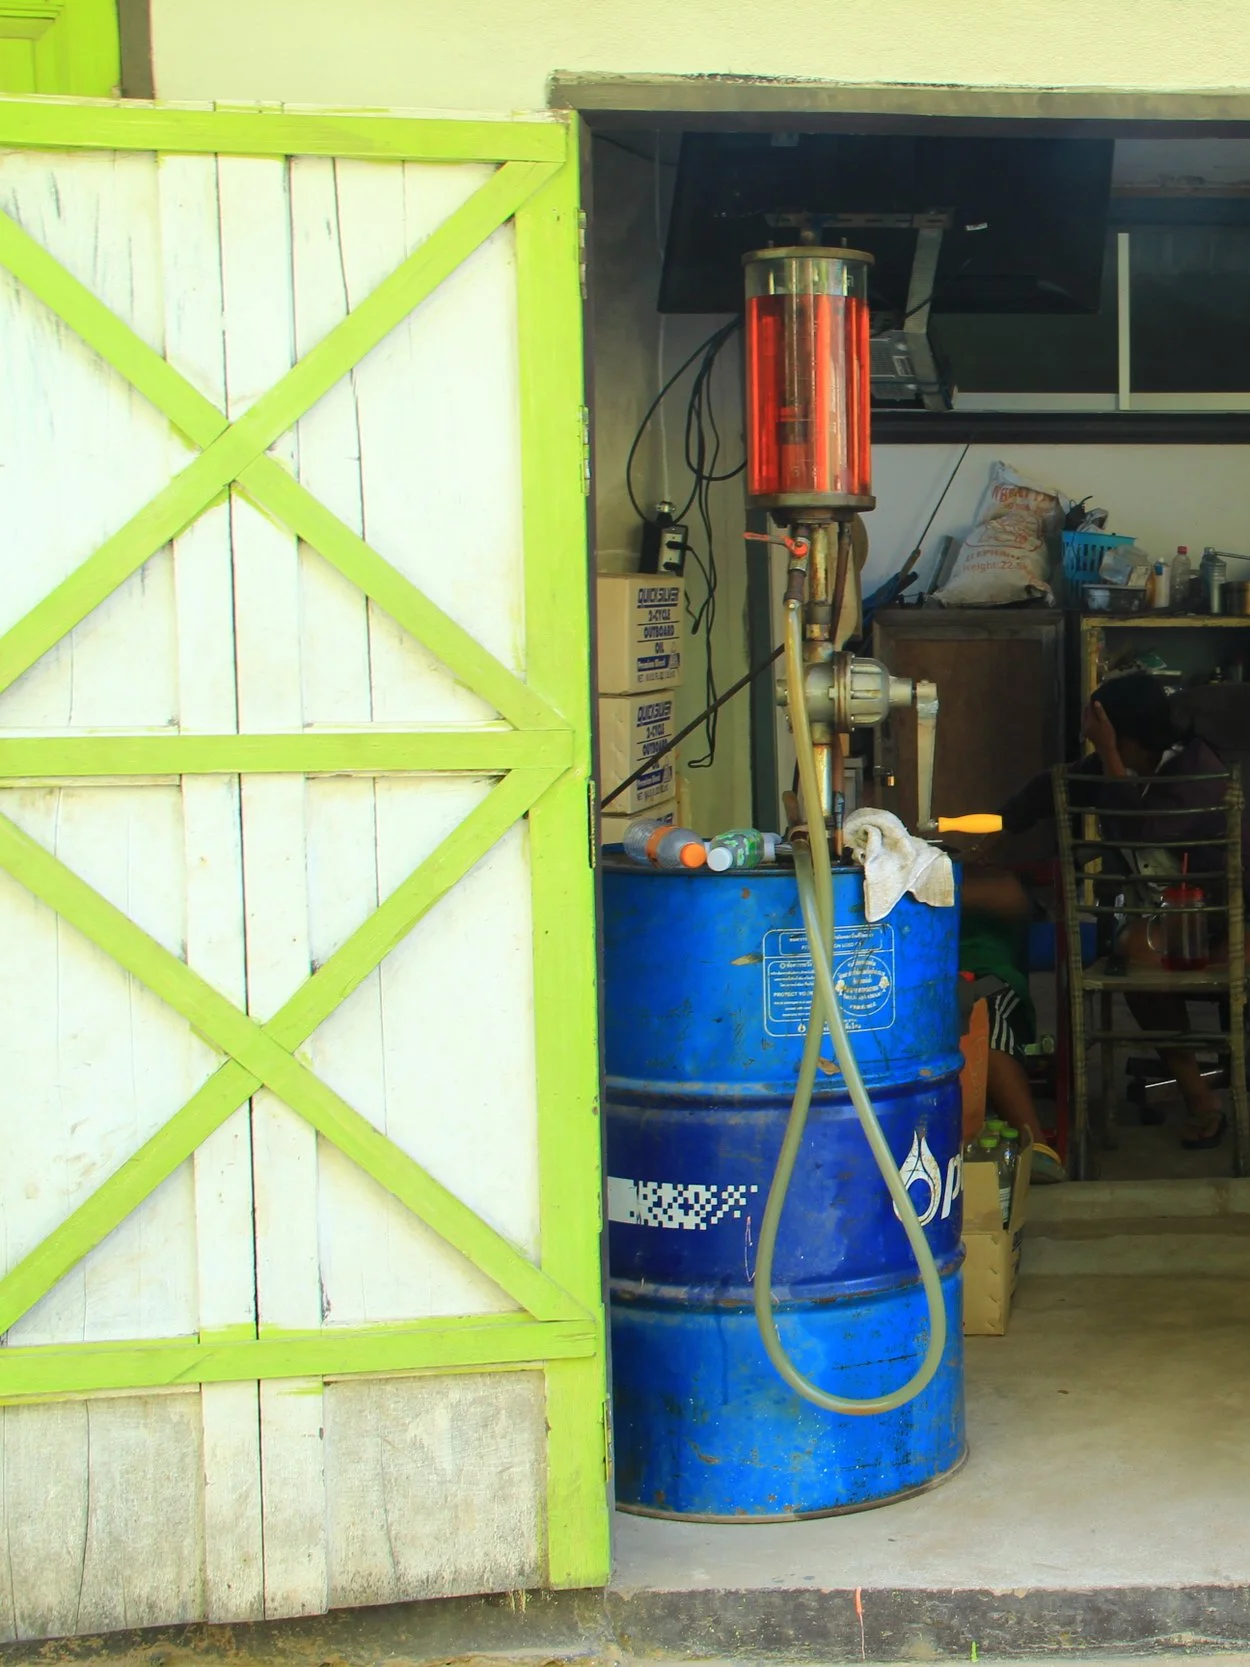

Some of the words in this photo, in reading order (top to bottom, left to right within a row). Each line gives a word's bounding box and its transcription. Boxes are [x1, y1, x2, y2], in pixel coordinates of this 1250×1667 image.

[638, 587, 680, 603] QUICKSILVER
[648, 608, 671, 622] 2-CYCLE
[643, 625, 675, 639] OUTBOARD
[655, 642, 665, 654] OIL
[637, 701, 673, 722] QUICKSILVER
